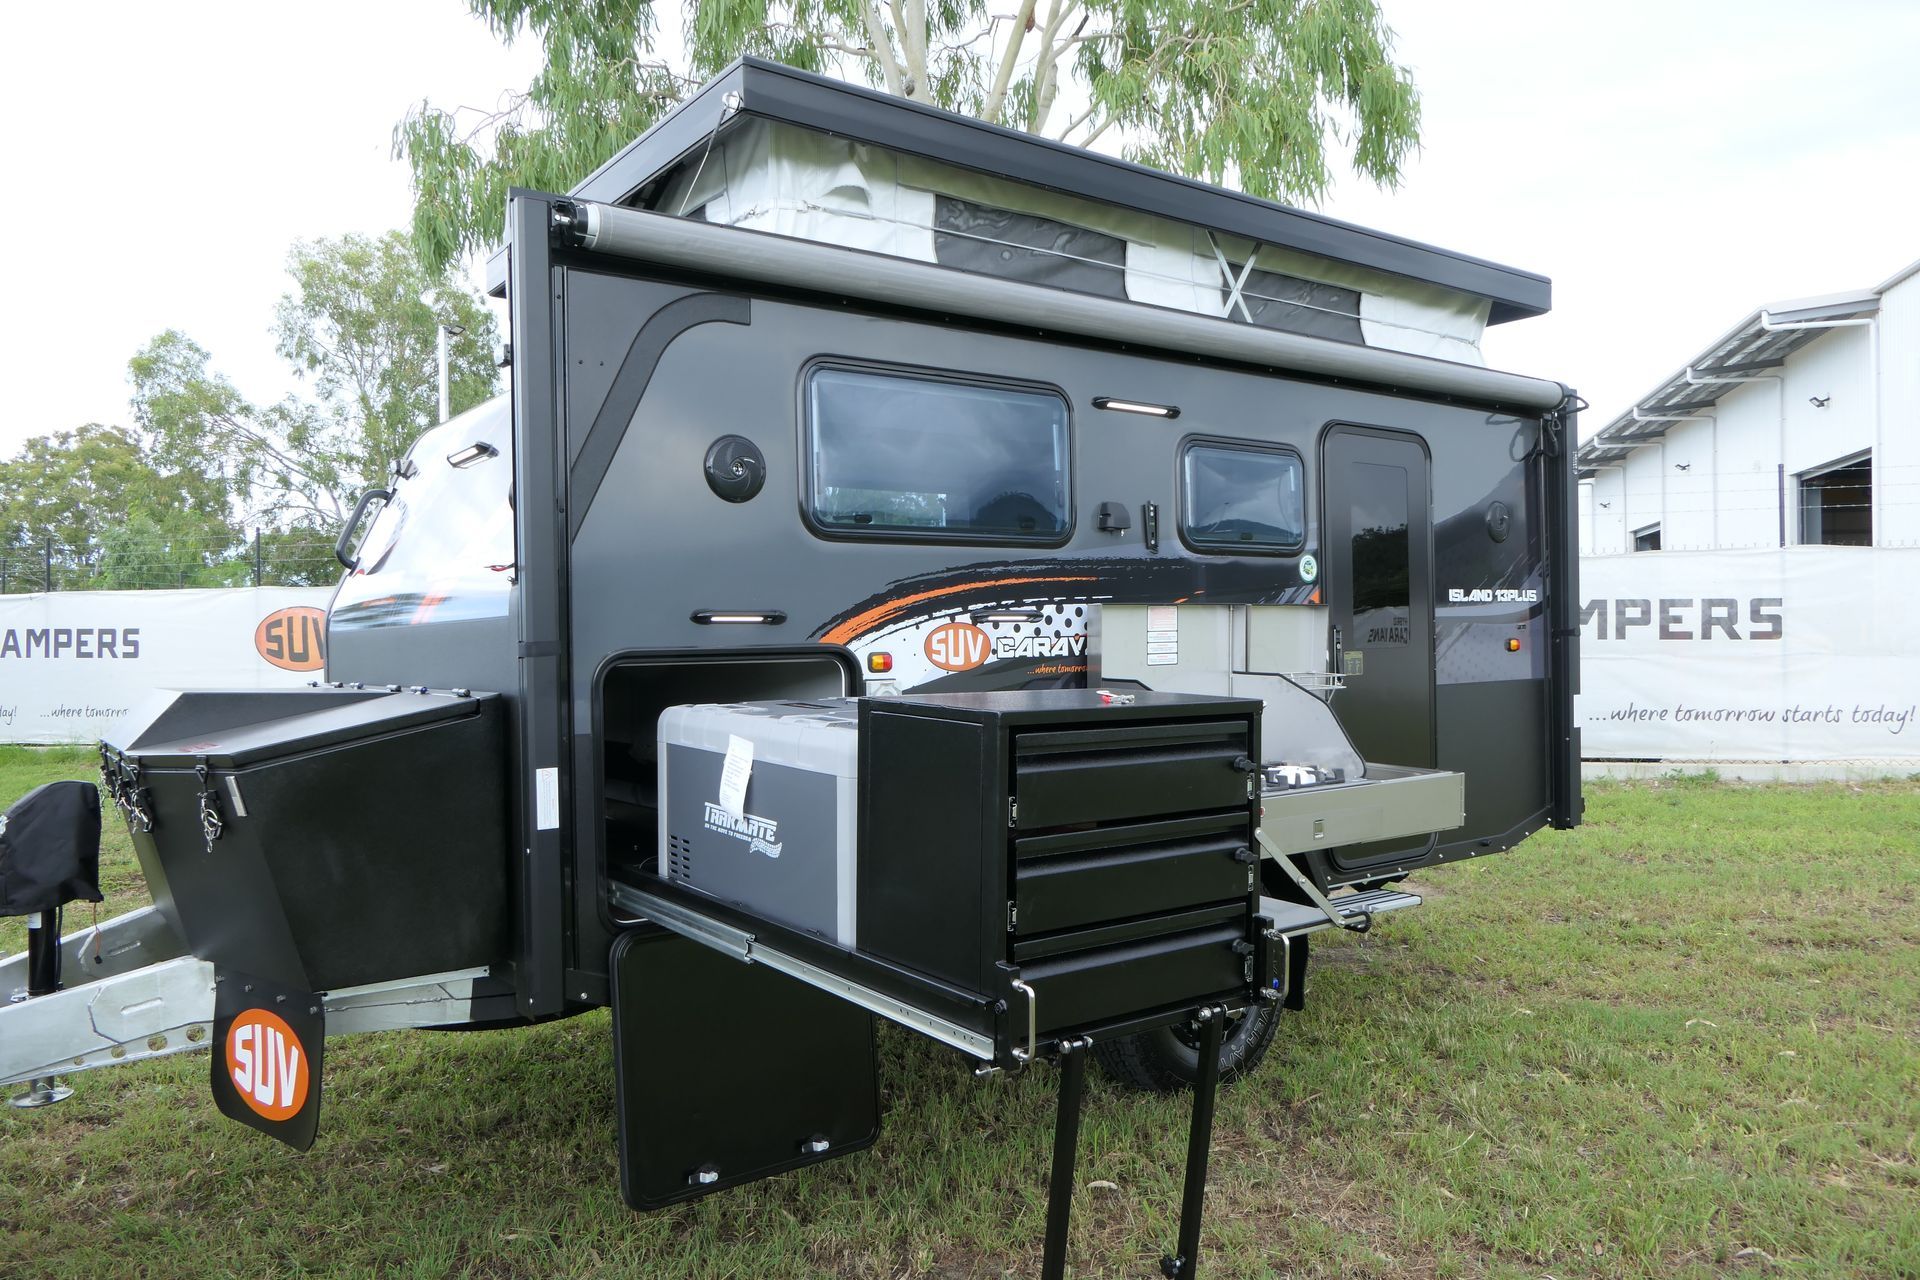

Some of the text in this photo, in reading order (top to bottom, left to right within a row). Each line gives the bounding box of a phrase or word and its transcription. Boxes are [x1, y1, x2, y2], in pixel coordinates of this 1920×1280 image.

[1448, 588, 1537, 602] ISLAND 13PLUS
[0, 628, 140, 659] AMPERS
[931, 628, 984, 666] SUV
[996, 636, 1088, 659] CARAV
[1589, 702, 1917, 735] ...where tomorrow starts today!
[234, 1023, 299, 1108] SUV
